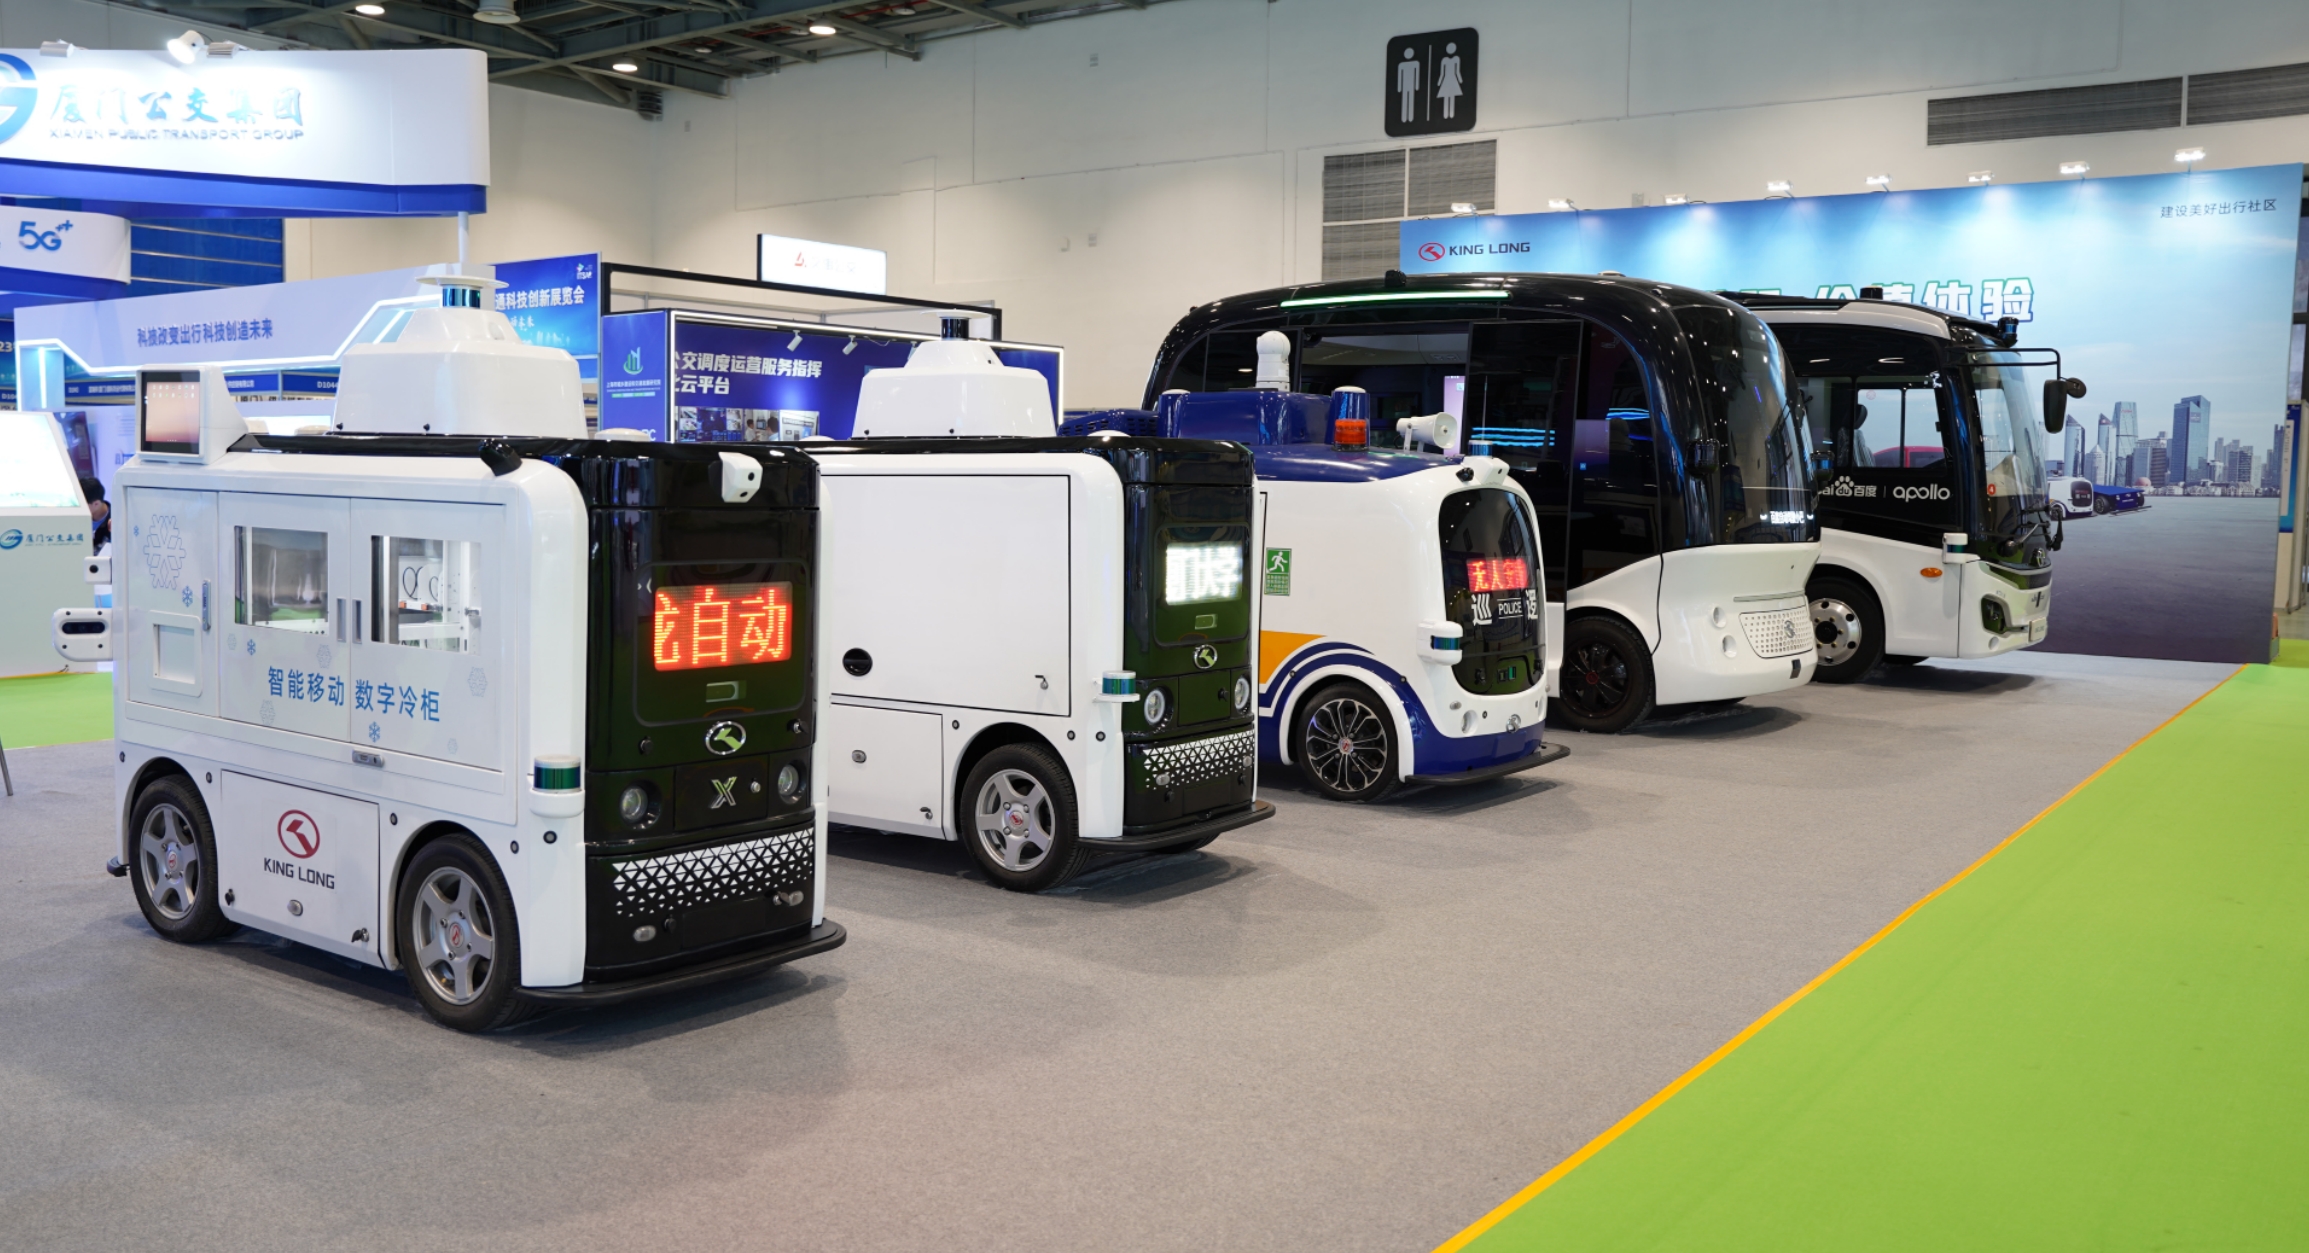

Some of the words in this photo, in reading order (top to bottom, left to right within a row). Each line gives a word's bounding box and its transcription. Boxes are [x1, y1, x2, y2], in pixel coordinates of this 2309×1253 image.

[49, 84, 304, 126] 厦门公交集团
[49, 129, 102, 140] XIAMEN
[108, 129, 159, 140] PUBLIC
[163, 129, 248, 140] TRANSPORT
[252, 129, 304, 140] GROUP
[2160, 198, 2277, 219] 建设美好出行社区
[1449, 244, 1484, 256] KING
[1489, 242, 1530, 254] LONG
[137, 318, 273, 347] 科技改变出行科技创造未来
[1854, 485, 1877, 498] 百度
[1893, 484, 1951, 502] apollo
[1471, 592, 1493, 626] 巡
[1498, 601, 1523, 616] POLICE
[268, 666, 345, 707] 智能移动
[355, 679, 440, 722] 数字冷柜
[263, 857, 294, 879] KING
[298, 866, 335, 890] LONG
